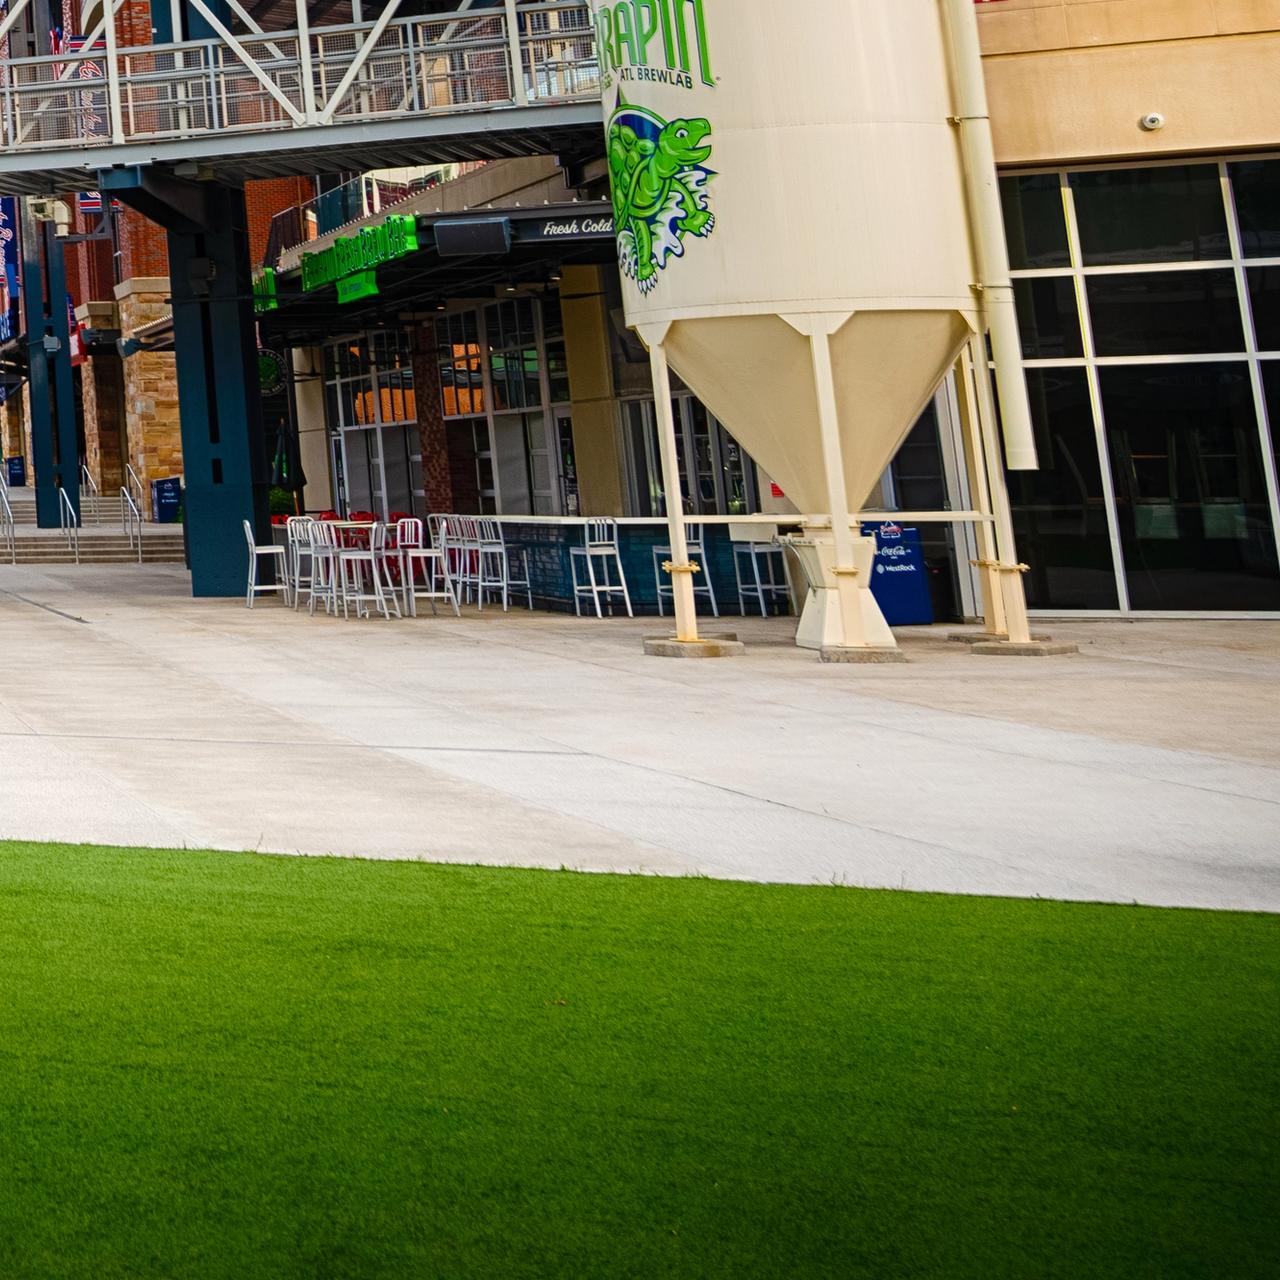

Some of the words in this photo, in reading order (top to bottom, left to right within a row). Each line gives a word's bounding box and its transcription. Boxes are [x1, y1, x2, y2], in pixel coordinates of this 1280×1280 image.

[620, 67, 634, 81] ATL
[637, 67, 693, 89] BREWLAB
[543, 220, 579, 235] Fresh
[582, 219, 613, 233] Cold
